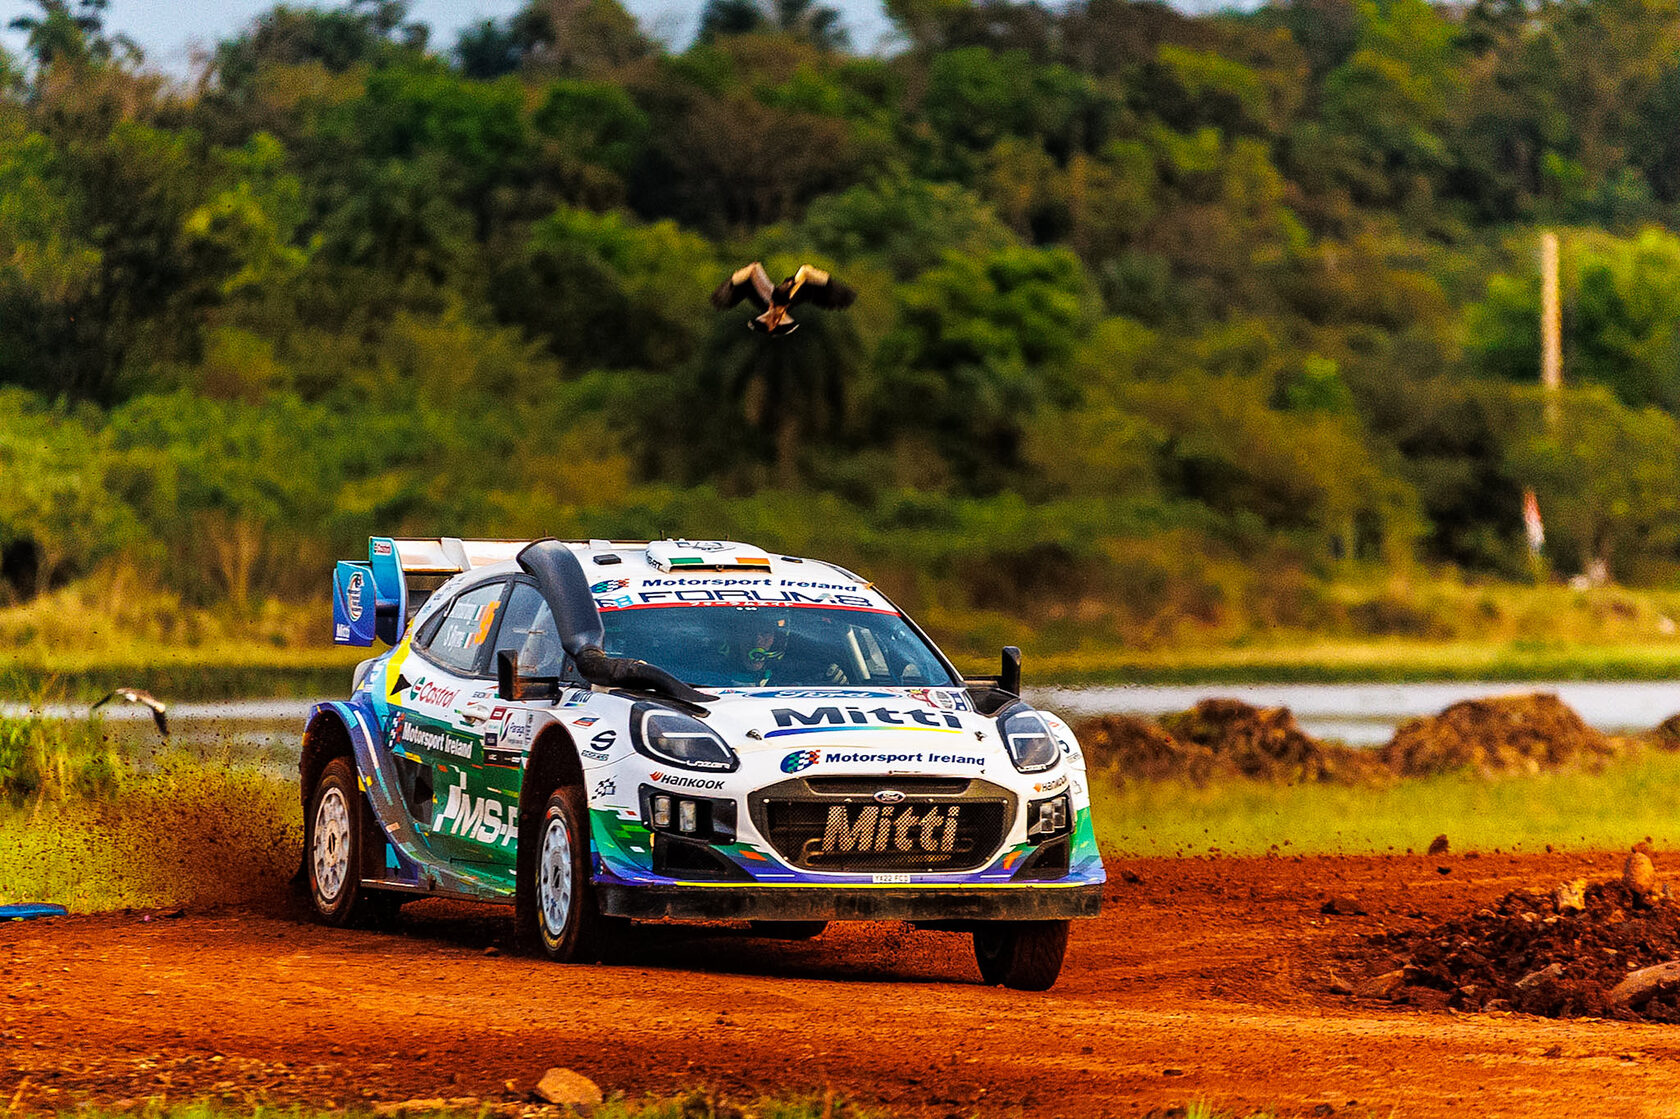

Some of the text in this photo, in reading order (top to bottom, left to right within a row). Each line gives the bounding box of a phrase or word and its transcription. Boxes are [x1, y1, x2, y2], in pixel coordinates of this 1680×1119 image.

[642, 578, 857, 592] Motorsport Ireland
[638, 590, 873, 607] FORUM8
[419, 682, 461, 708] Castrol
[777, 689, 872, 699] Ford
[771, 706, 963, 729] Mitti
[402, 721, 474, 759] Motorsport Ireland
[825, 753, 985, 766] Motorsport Ireland
[881, 792, 900, 802] Ford
[822, 805, 961, 852] Mitti
